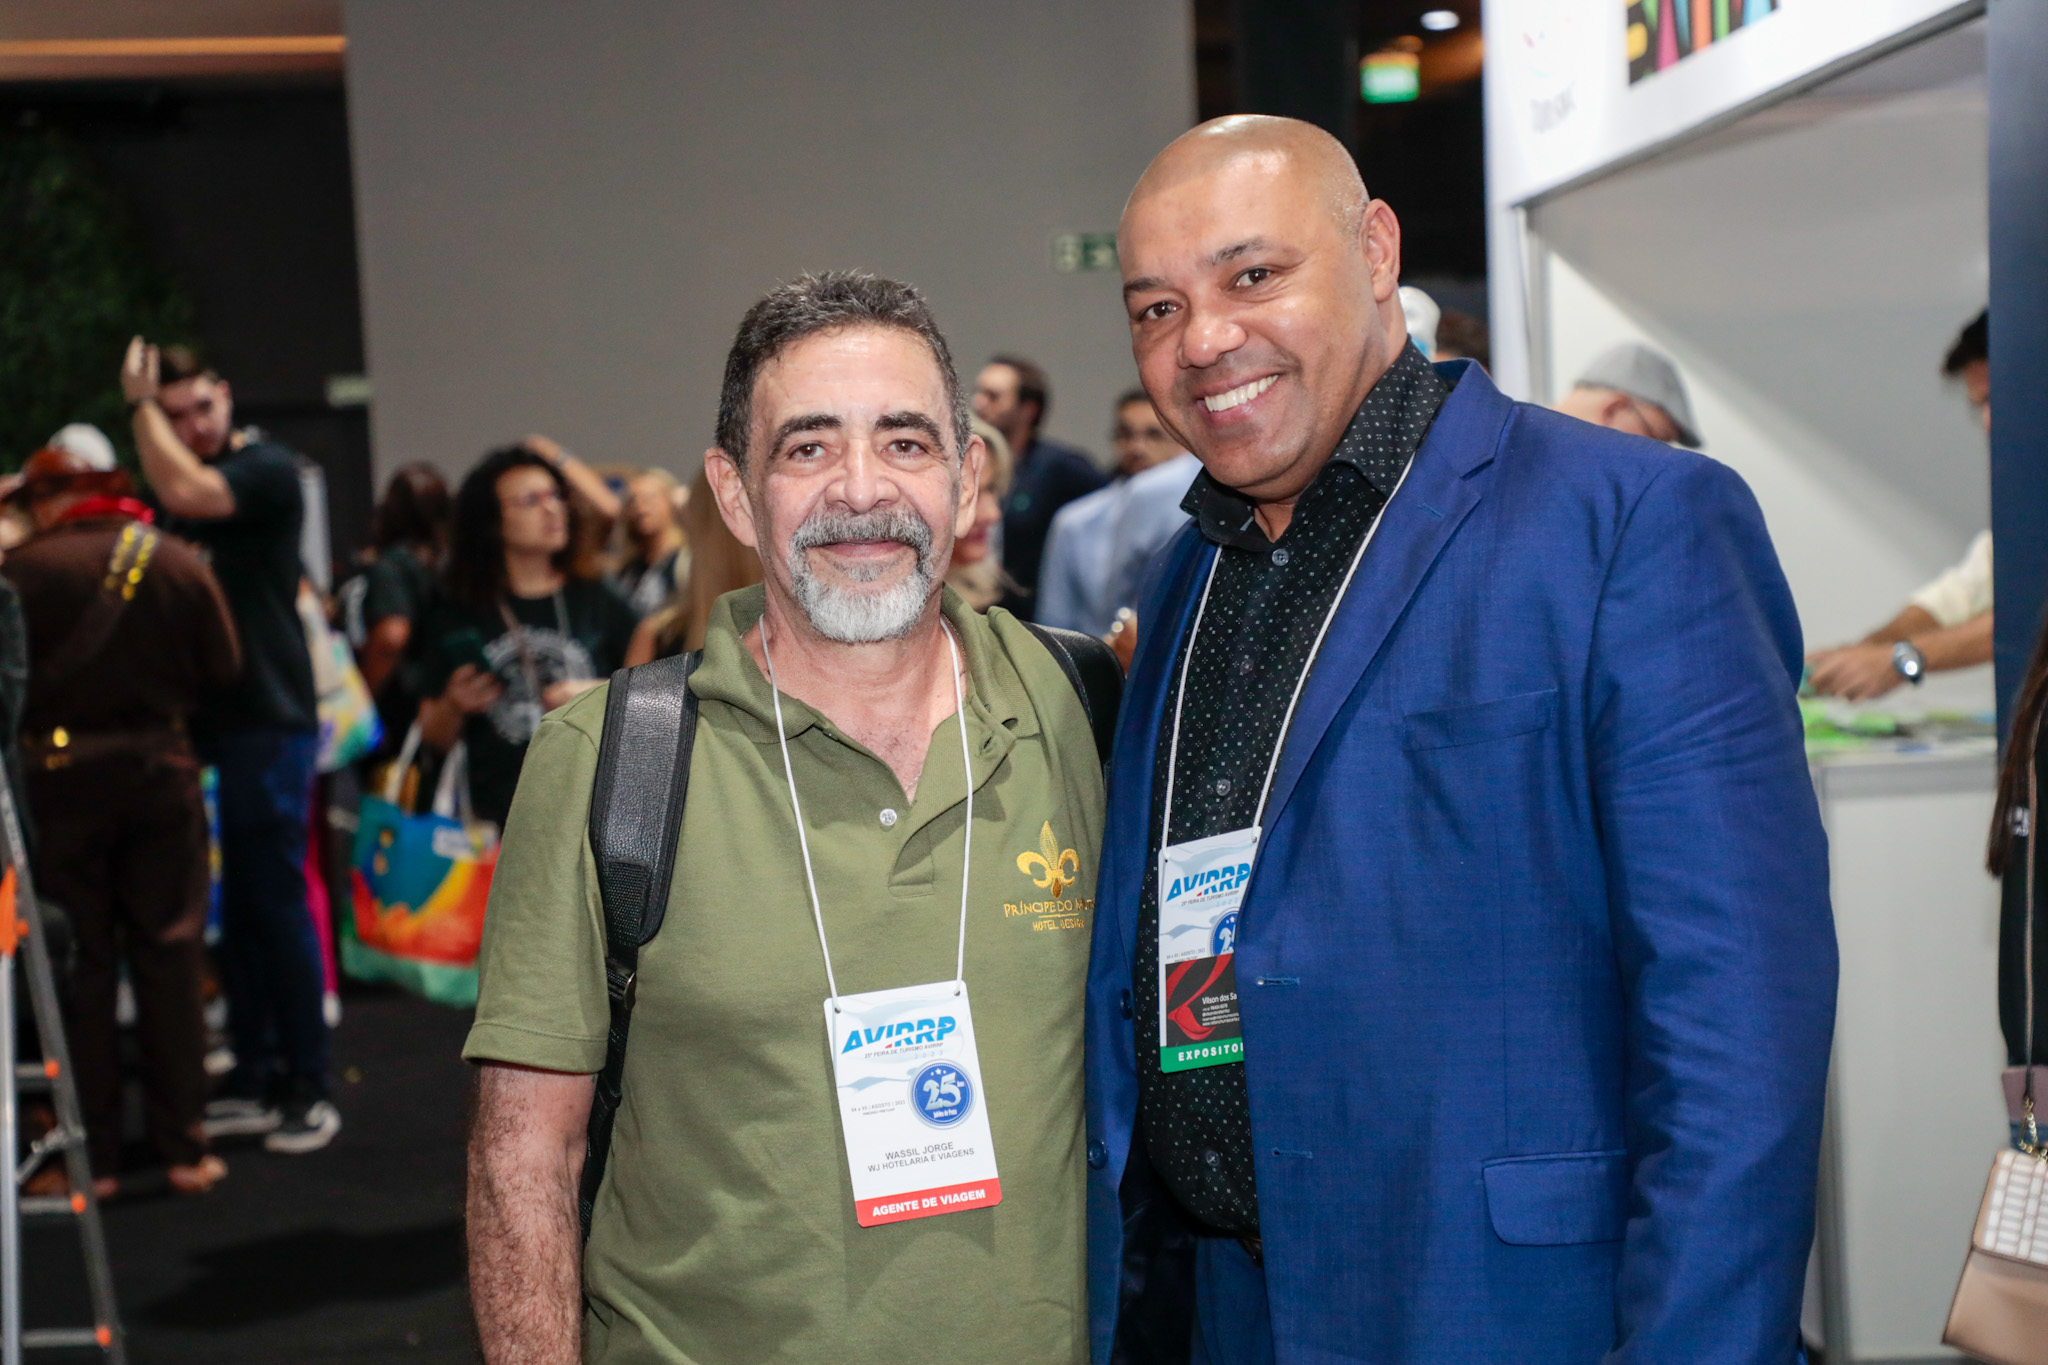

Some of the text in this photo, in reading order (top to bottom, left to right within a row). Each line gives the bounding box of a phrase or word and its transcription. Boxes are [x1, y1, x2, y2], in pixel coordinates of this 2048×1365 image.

[1166, 863, 1251, 903] AVIRRP
[1057, 900, 1073, 912] DO
[1032, 919, 1059, 931] HOTEL
[1219, 924, 1236, 955] 2
[1230, 992, 1238, 1001] Sa
[841, 1016, 956, 1055] AVIRRP
[874, 1049, 890, 1058] FEIRA
[890, 1047, 898, 1055] DE
[900, 1045, 924, 1053] TURISMO
[923, 1072, 962, 1111] 25
[868, 1164, 881, 1172] WJ
[882, 1156, 929, 1170] HOTELARIA
[938, 1148, 975, 1160] VIAGENS
[885, 1141, 954, 1160] WASSIL JORGE
[872, 1188, 986, 1217] AGENTE DE VIAGEM
